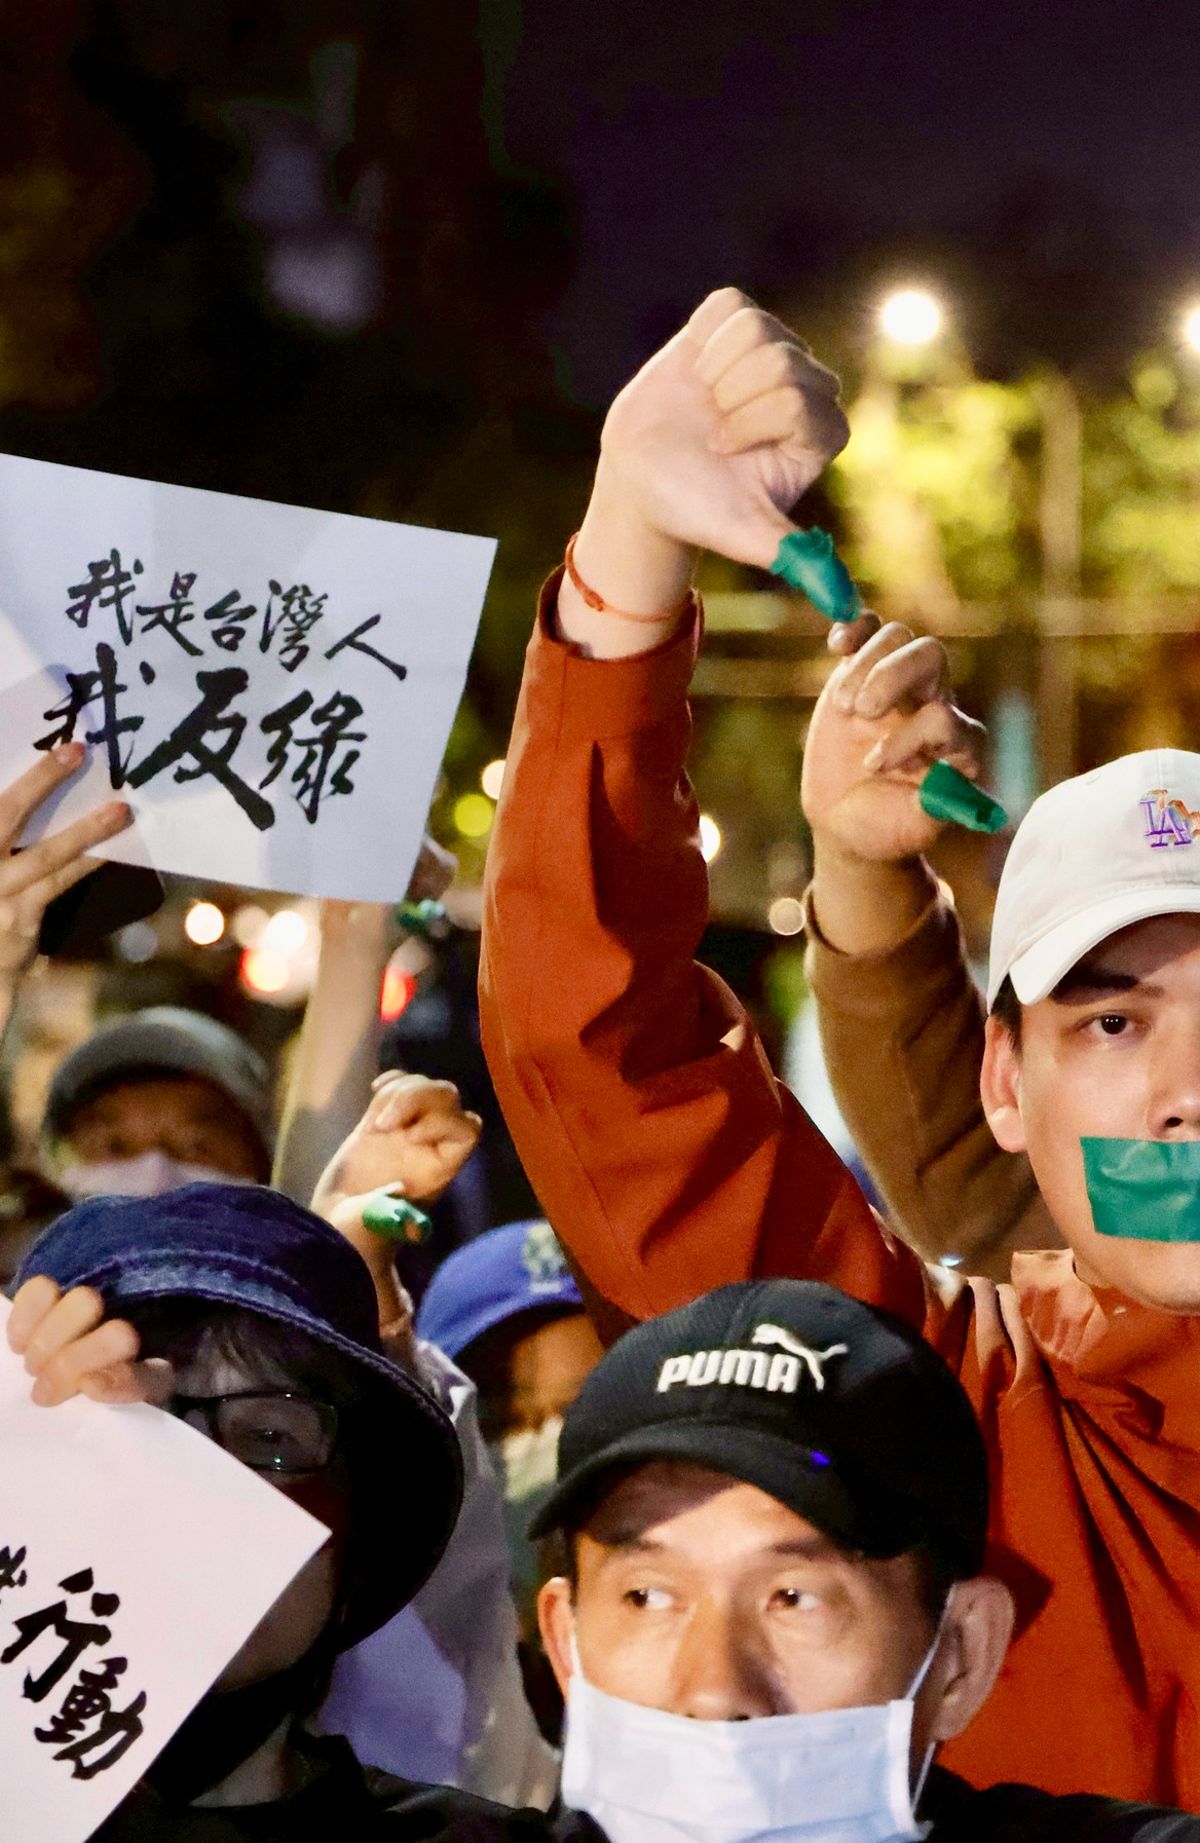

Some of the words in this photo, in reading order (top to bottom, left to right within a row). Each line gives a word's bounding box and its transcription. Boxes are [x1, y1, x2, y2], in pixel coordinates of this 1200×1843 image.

[66, 548, 406, 680] 我是台灣人
[33, 642, 367, 831] 我反綠
[1139, 798, 1193, 848] LA
[657, 1350, 801, 1393] PUMA
